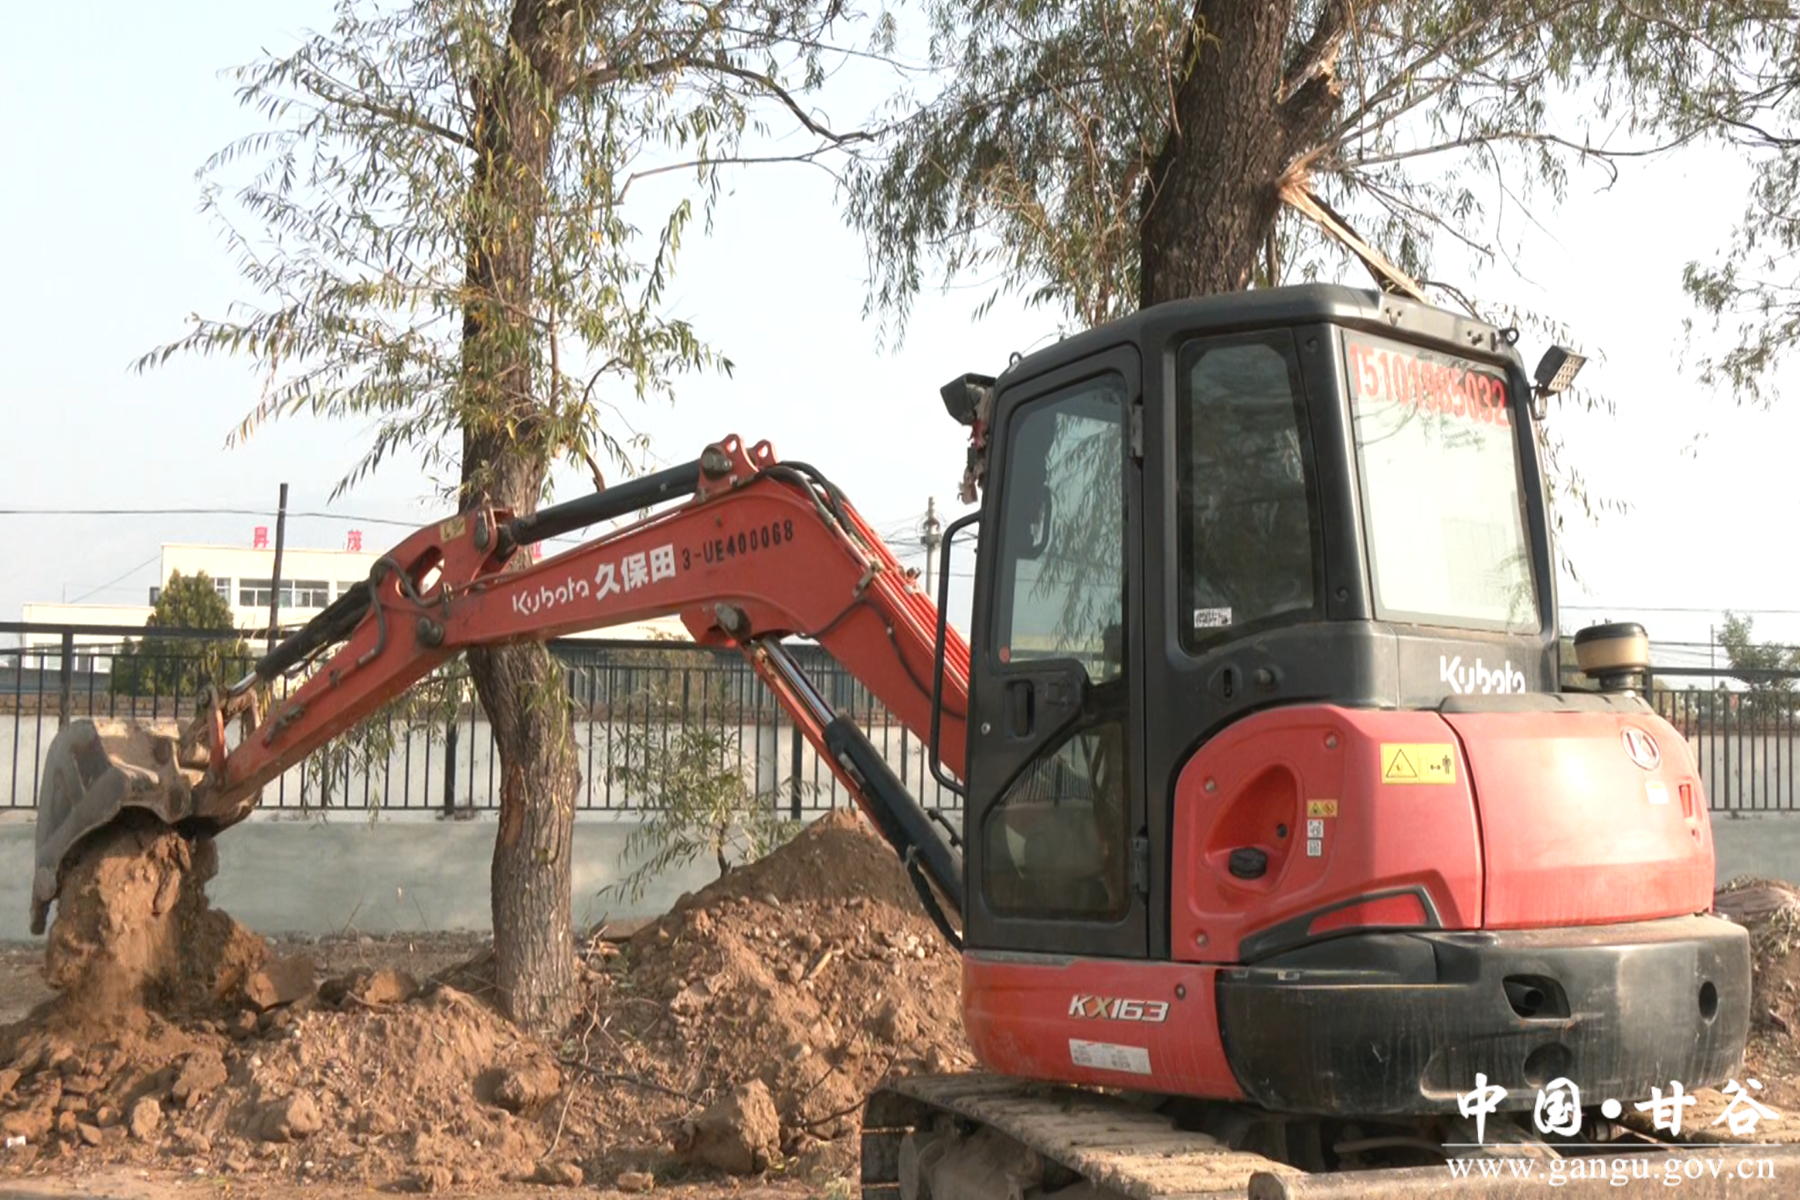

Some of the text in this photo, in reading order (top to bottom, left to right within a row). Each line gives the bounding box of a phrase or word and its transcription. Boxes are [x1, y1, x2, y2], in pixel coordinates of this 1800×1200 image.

[512, 543, 676, 616] Kubota 久保田
[1440, 655, 1525, 694] Kubota
[1068, 995, 1170, 1023] KX163
